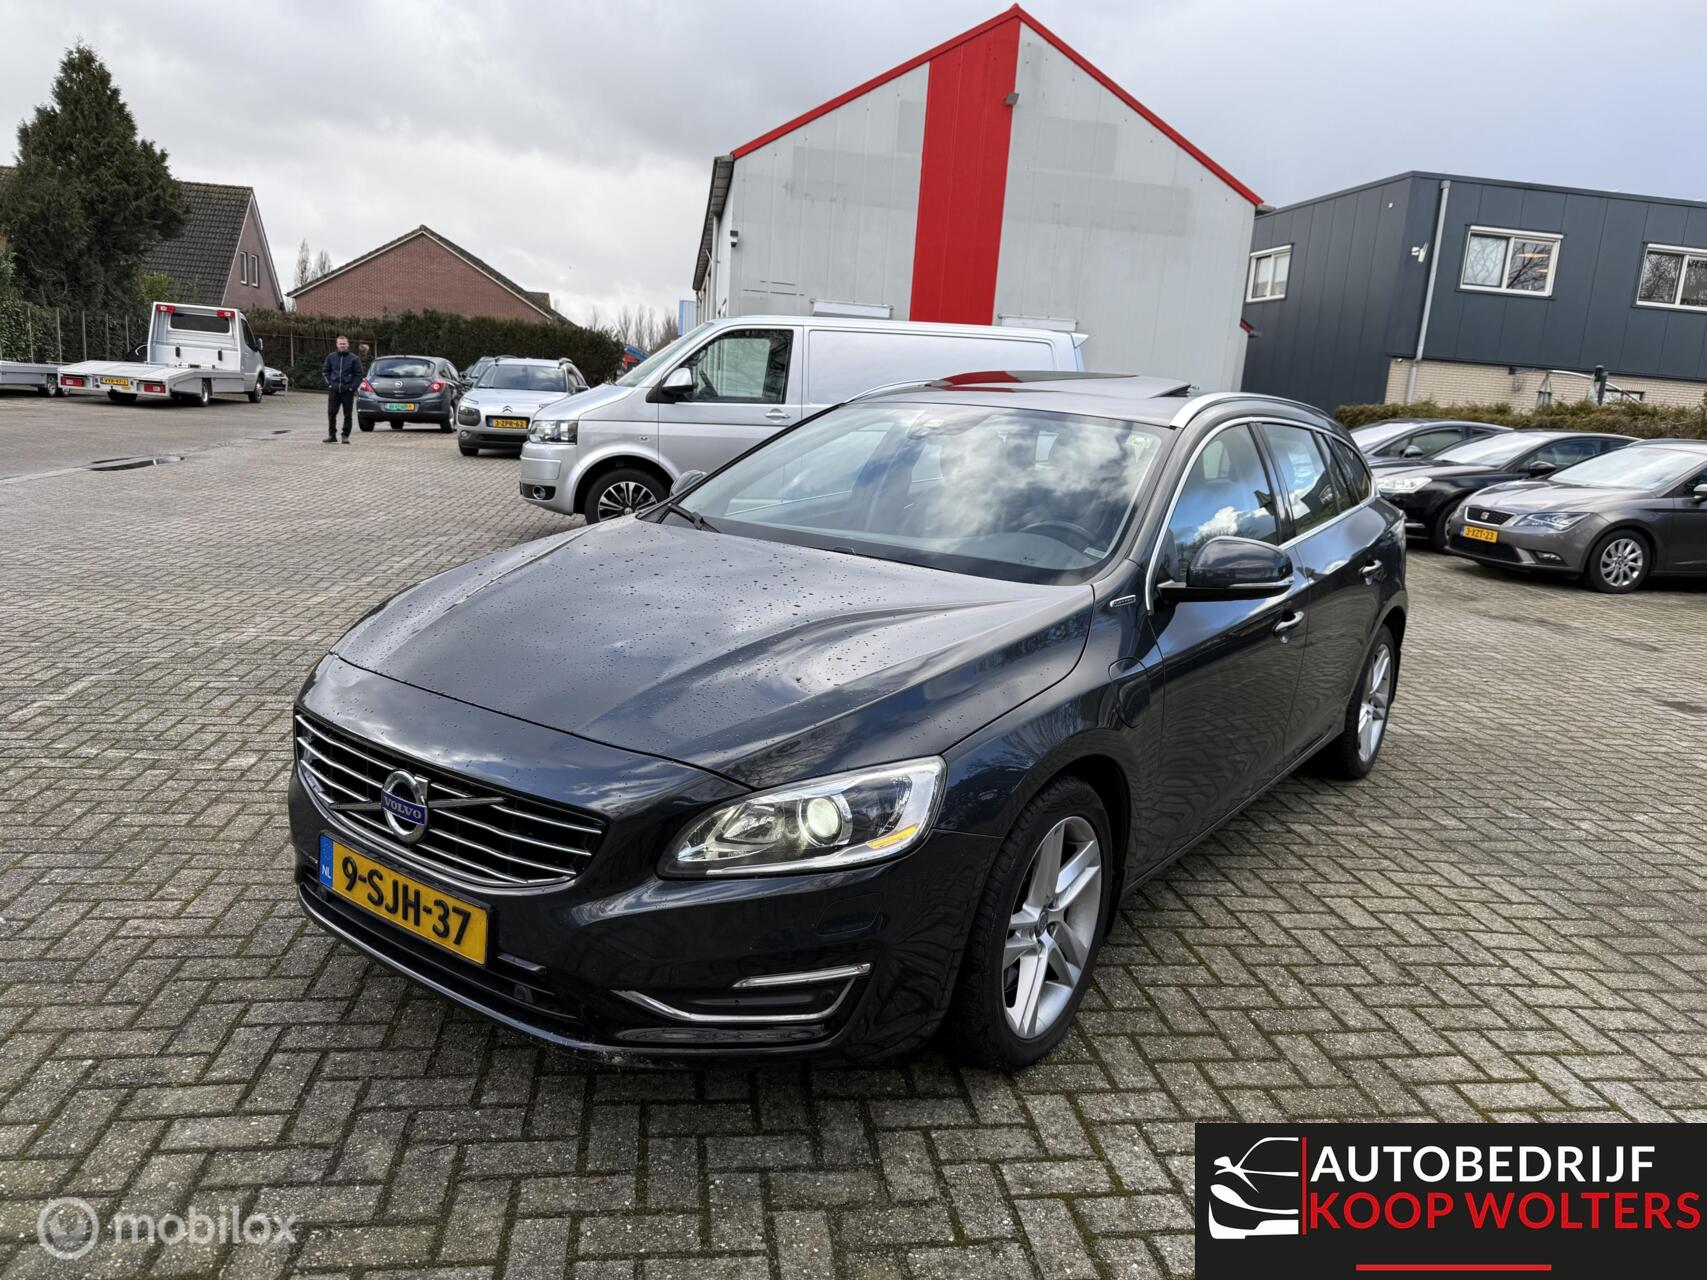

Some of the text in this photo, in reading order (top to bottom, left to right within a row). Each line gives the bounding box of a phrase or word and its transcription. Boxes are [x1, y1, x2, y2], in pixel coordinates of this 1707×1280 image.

[383, 794, 422, 820] VOLVO
[321, 864, 332, 879] NL
[341, 855, 472, 946] 9-SJH-37
